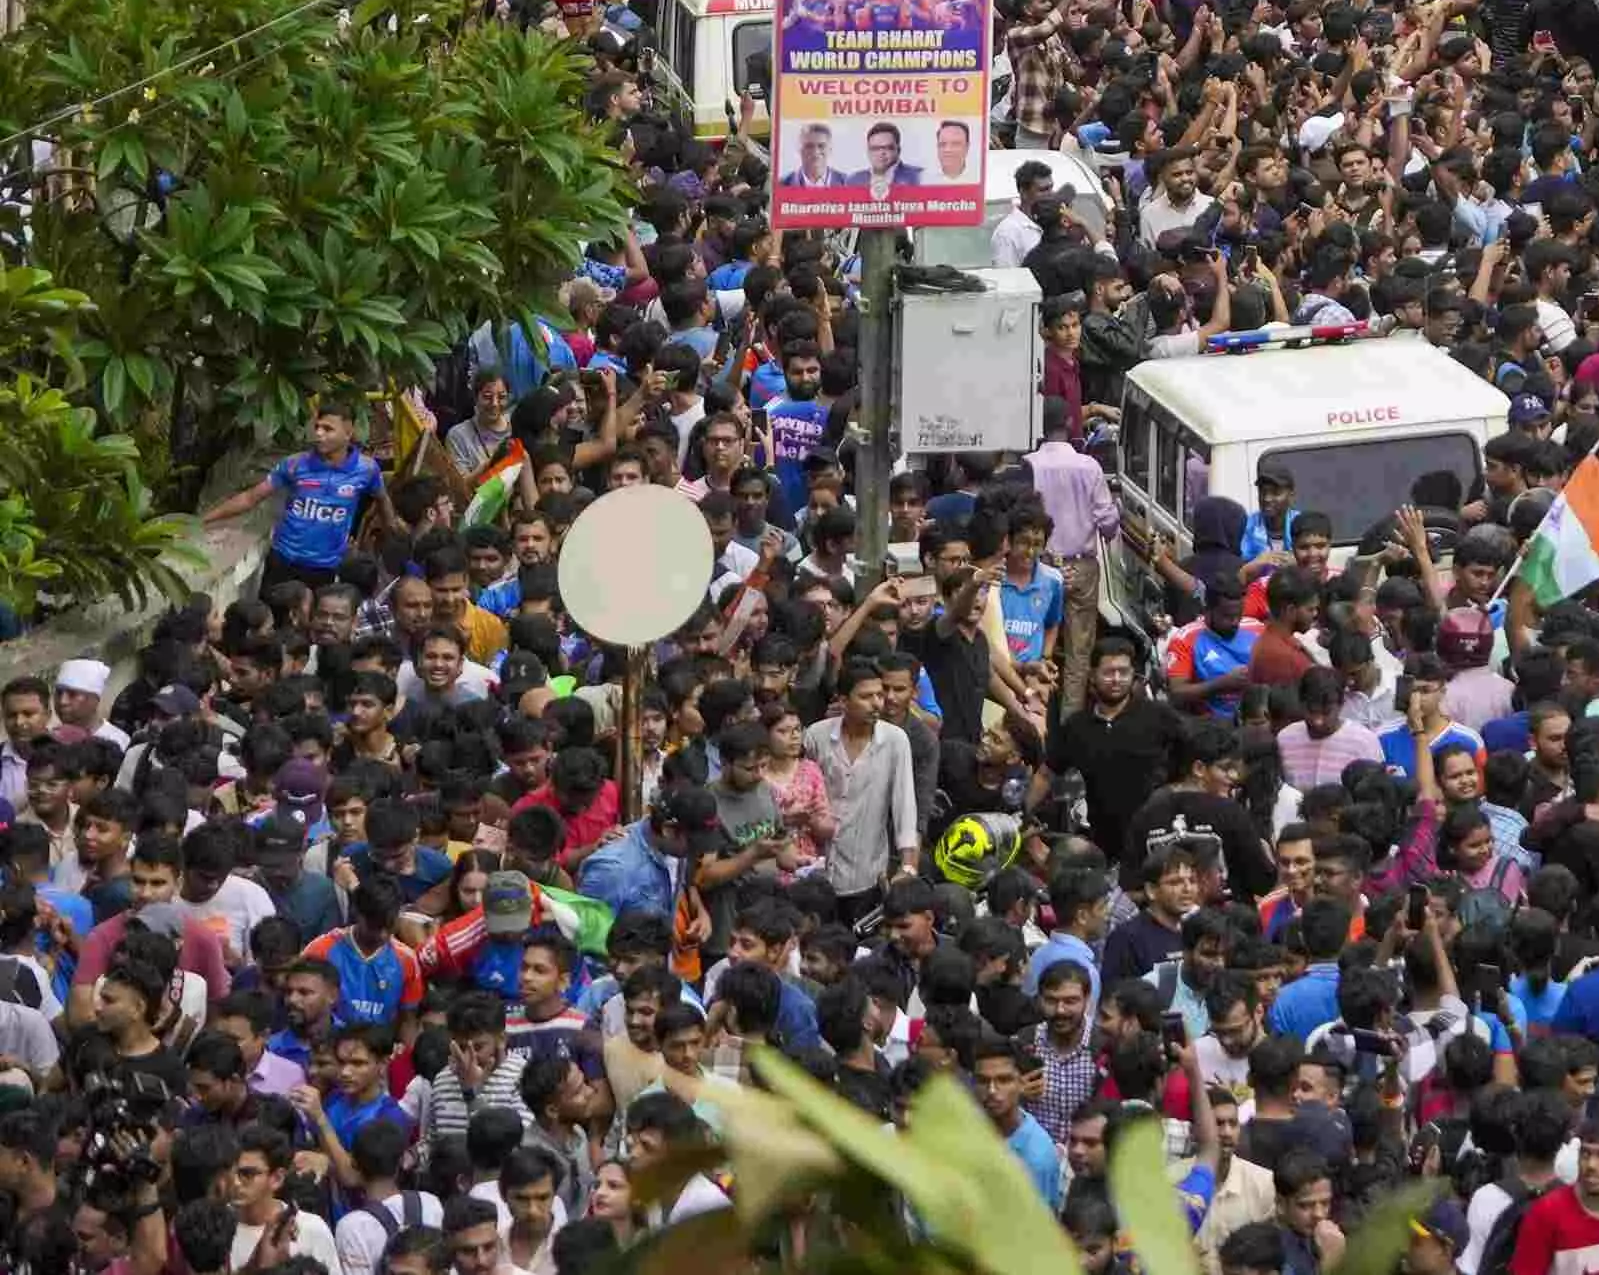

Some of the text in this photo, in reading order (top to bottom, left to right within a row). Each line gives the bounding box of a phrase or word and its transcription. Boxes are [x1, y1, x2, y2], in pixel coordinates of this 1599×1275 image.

[825, 29, 945, 49] TEAM BHARAT
[790, 49, 977, 70] WORLD CHAMPIONS
[799, 77, 969, 95] WELCOME TO
[832, 98, 936, 115] MUMBAI
[1327, 407, 1401, 426] POLICE
[292, 497, 348, 523] slice
